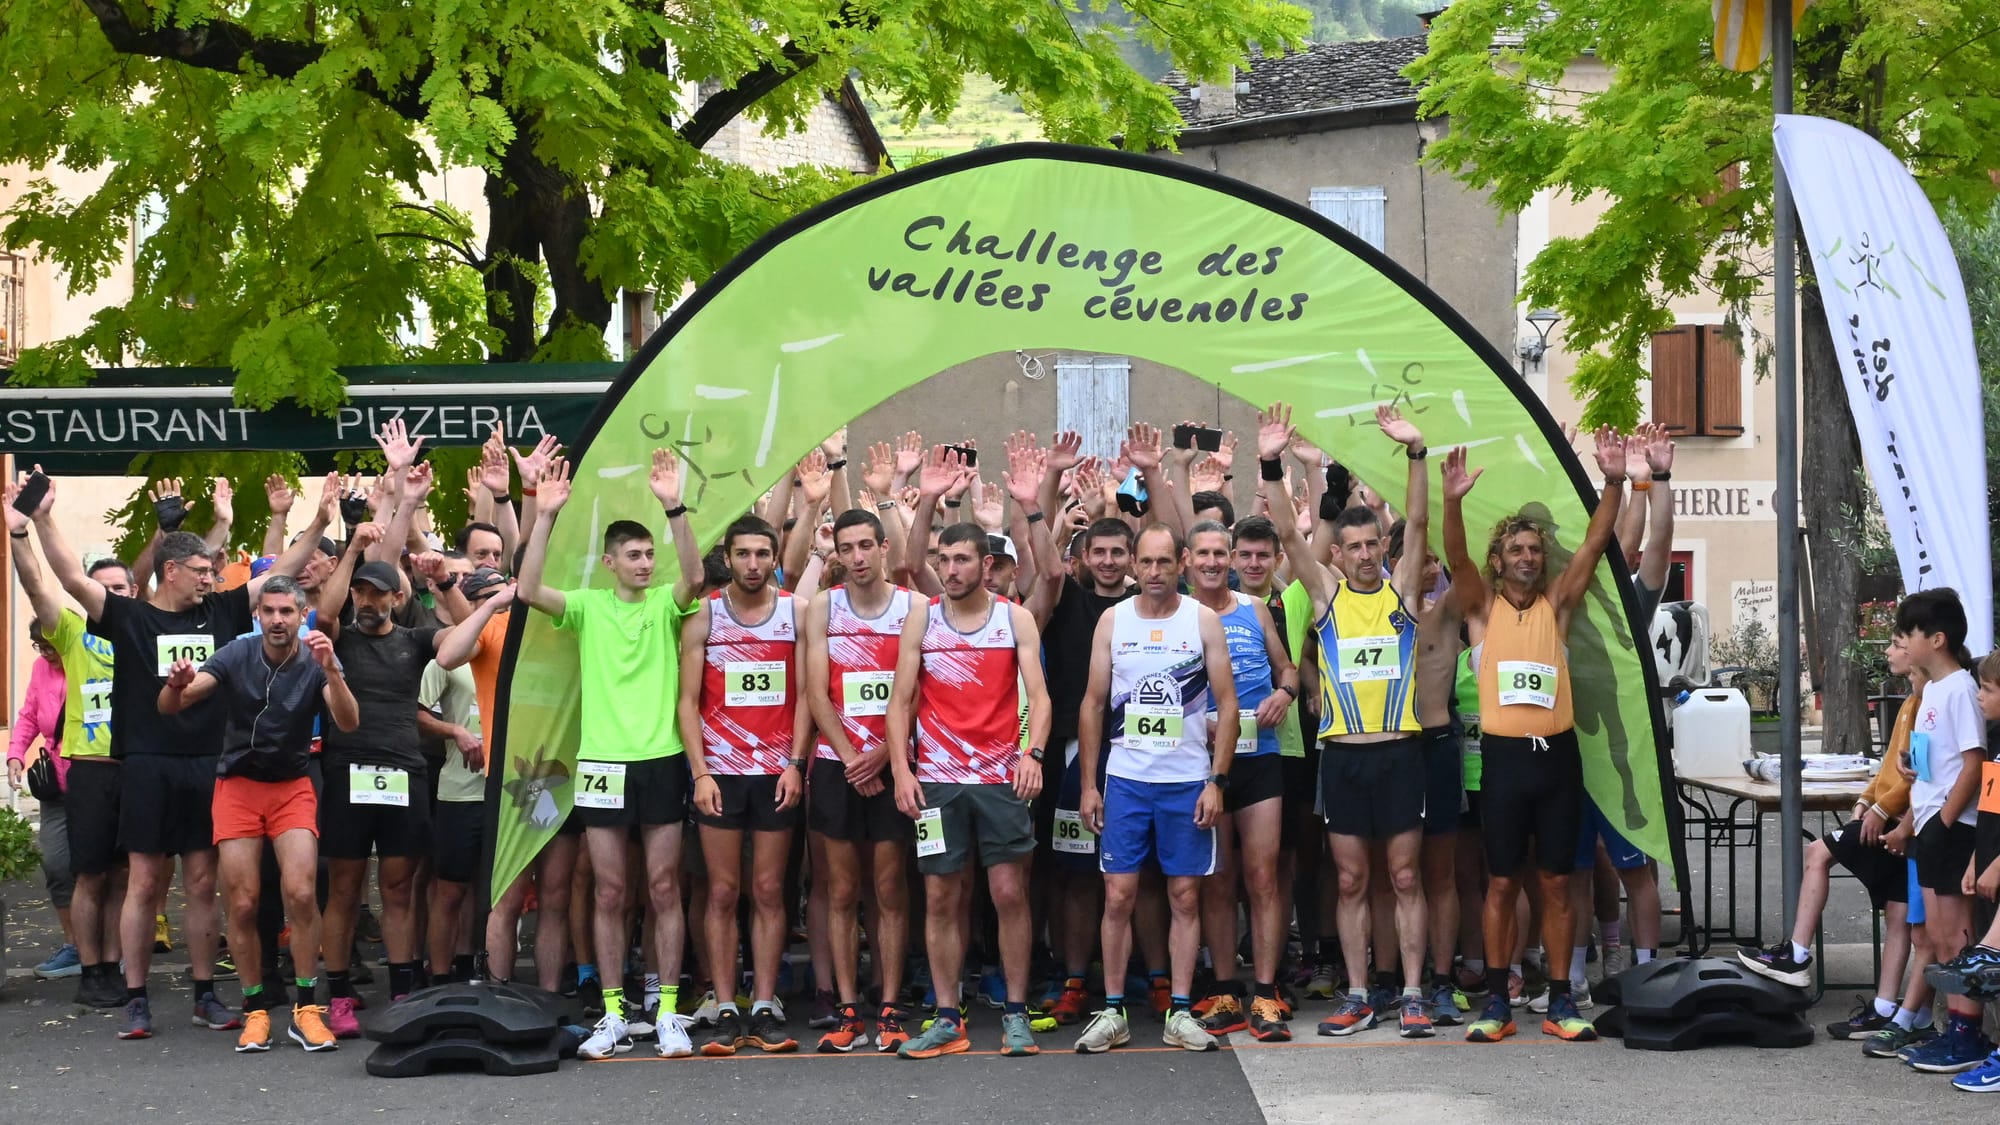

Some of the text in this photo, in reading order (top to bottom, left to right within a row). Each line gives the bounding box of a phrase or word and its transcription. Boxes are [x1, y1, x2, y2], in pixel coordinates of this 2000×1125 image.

[904, 216, 1284, 287] Challenge des
[868, 266, 1309, 323] vallées cévenoles
[336, 405, 549, 440] PIZZERIA
[168, 646, 207, 662] 103
[1354, 648, 1383, 666] 47
[741, 674, 771, 691] 83
[1513, 672, 1542, 691] 89
[860, 683, 889, 701] 60
[1138, 717, 1167, 736] 64
[374, 775, 387, 791] 6
[584, 775, 608, 793] 74
[1060, 821, 1080, 839] 96
